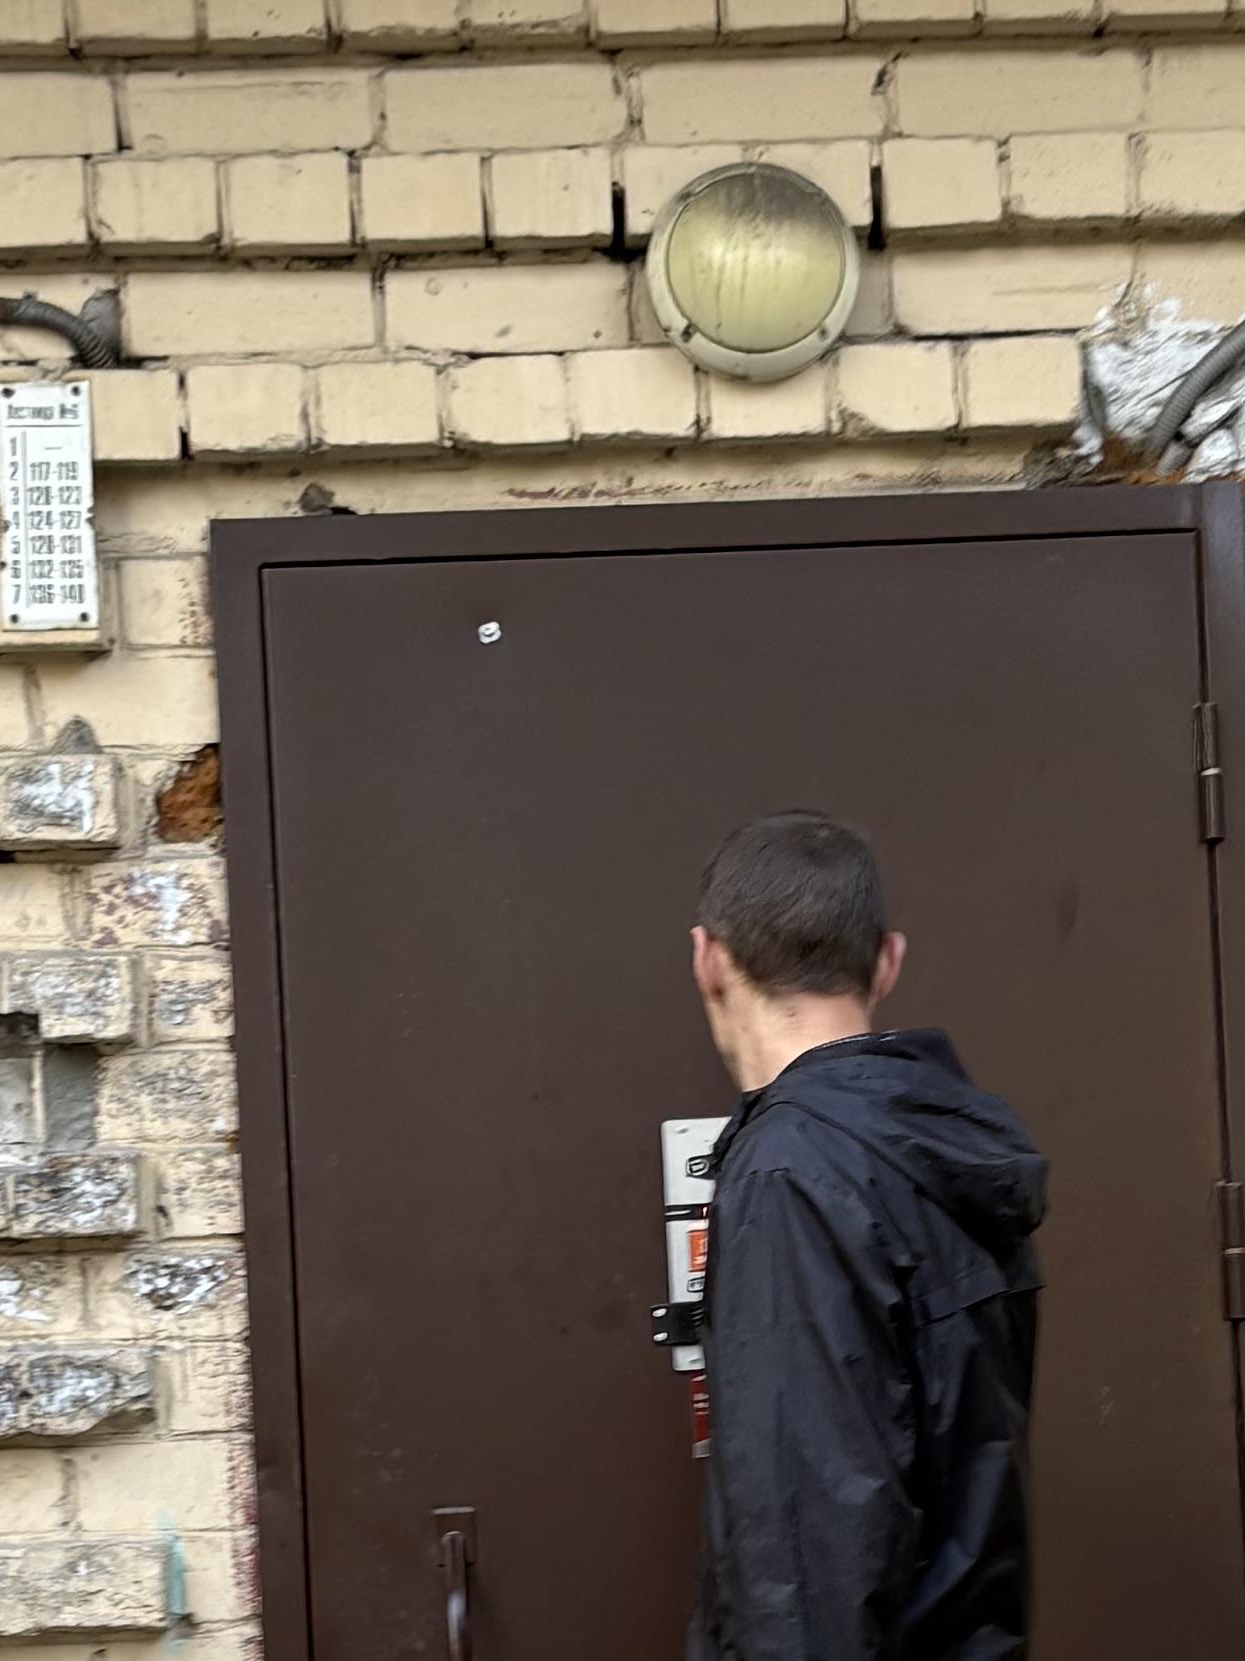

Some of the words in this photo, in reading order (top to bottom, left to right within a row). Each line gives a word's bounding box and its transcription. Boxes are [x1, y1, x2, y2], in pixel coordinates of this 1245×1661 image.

[10, 436, 17, 457] 1
[9, 461, 19, 481] 2
[9, 486, 20, 506] 3
[10, 535, 21, 555] 5
[10, 559, 21, 579] 6
[12, 583, 21, 604] 7
